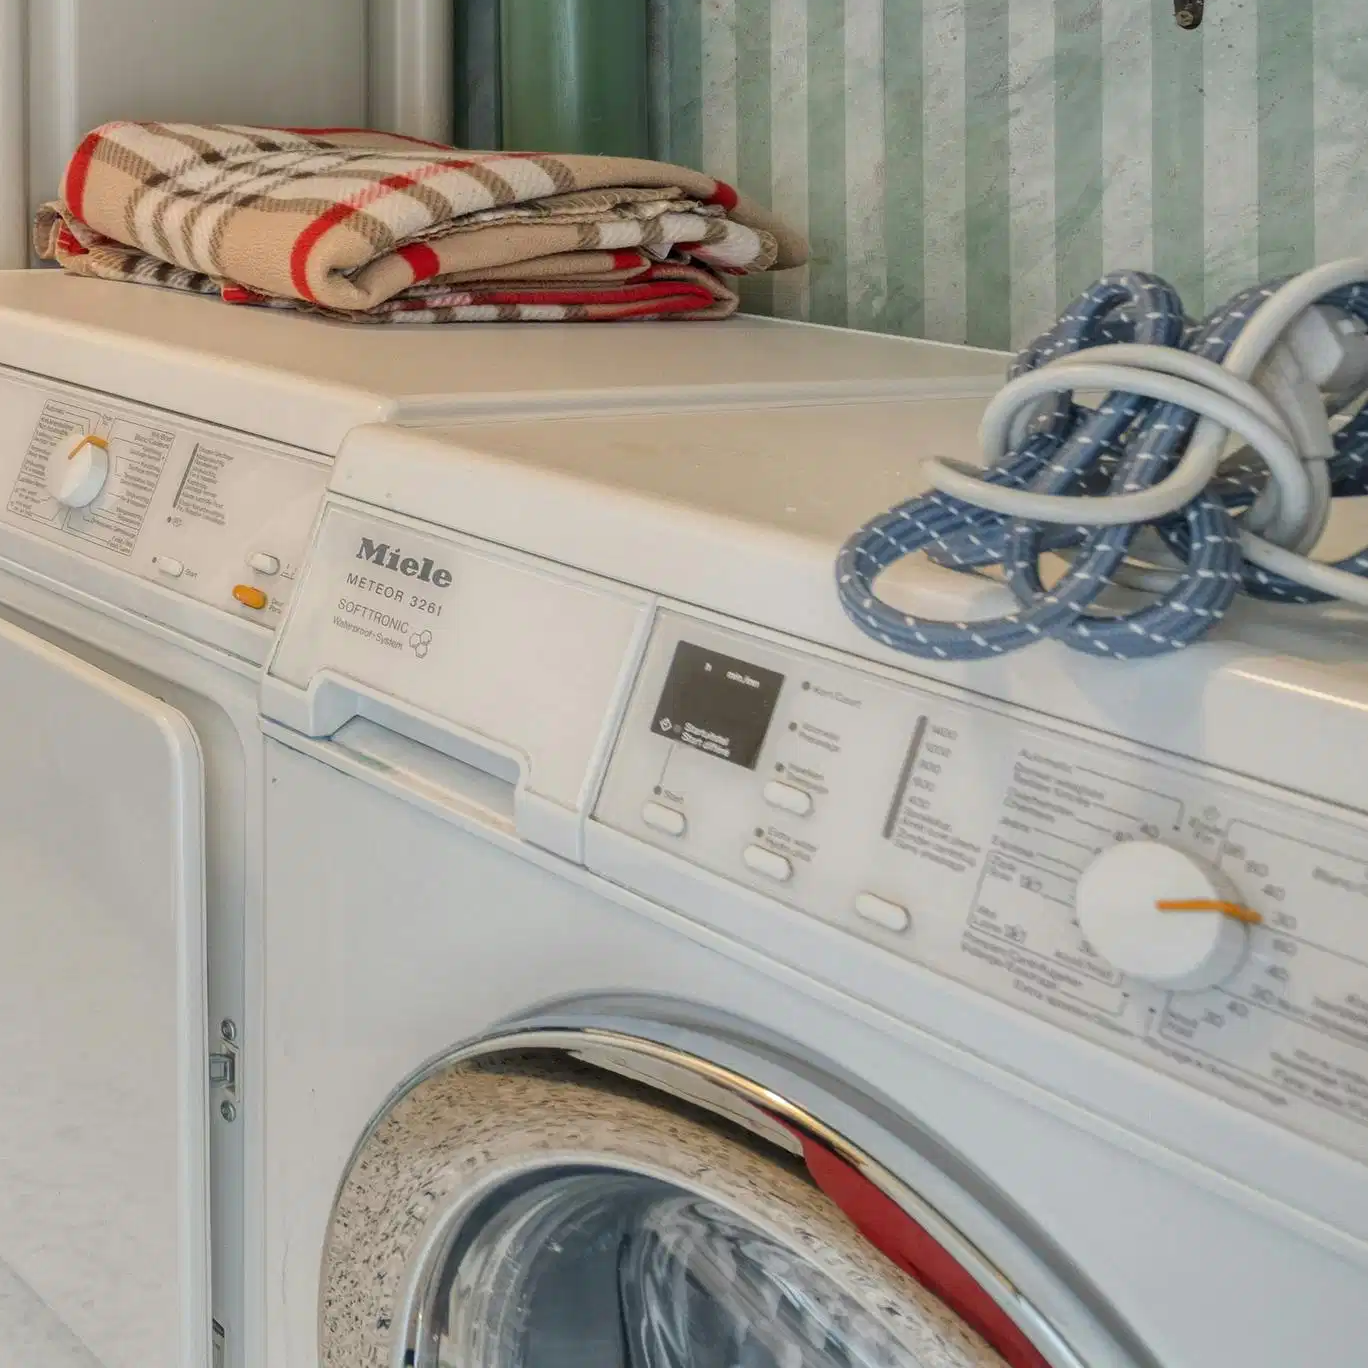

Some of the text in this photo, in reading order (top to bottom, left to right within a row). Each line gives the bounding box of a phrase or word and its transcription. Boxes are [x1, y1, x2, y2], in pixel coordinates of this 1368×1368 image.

[355, 537, 453, 588] Miele
[337, 598, 409, 634] SOFTTRONIC
[346, 572, 443, 617] METEOR 3261
